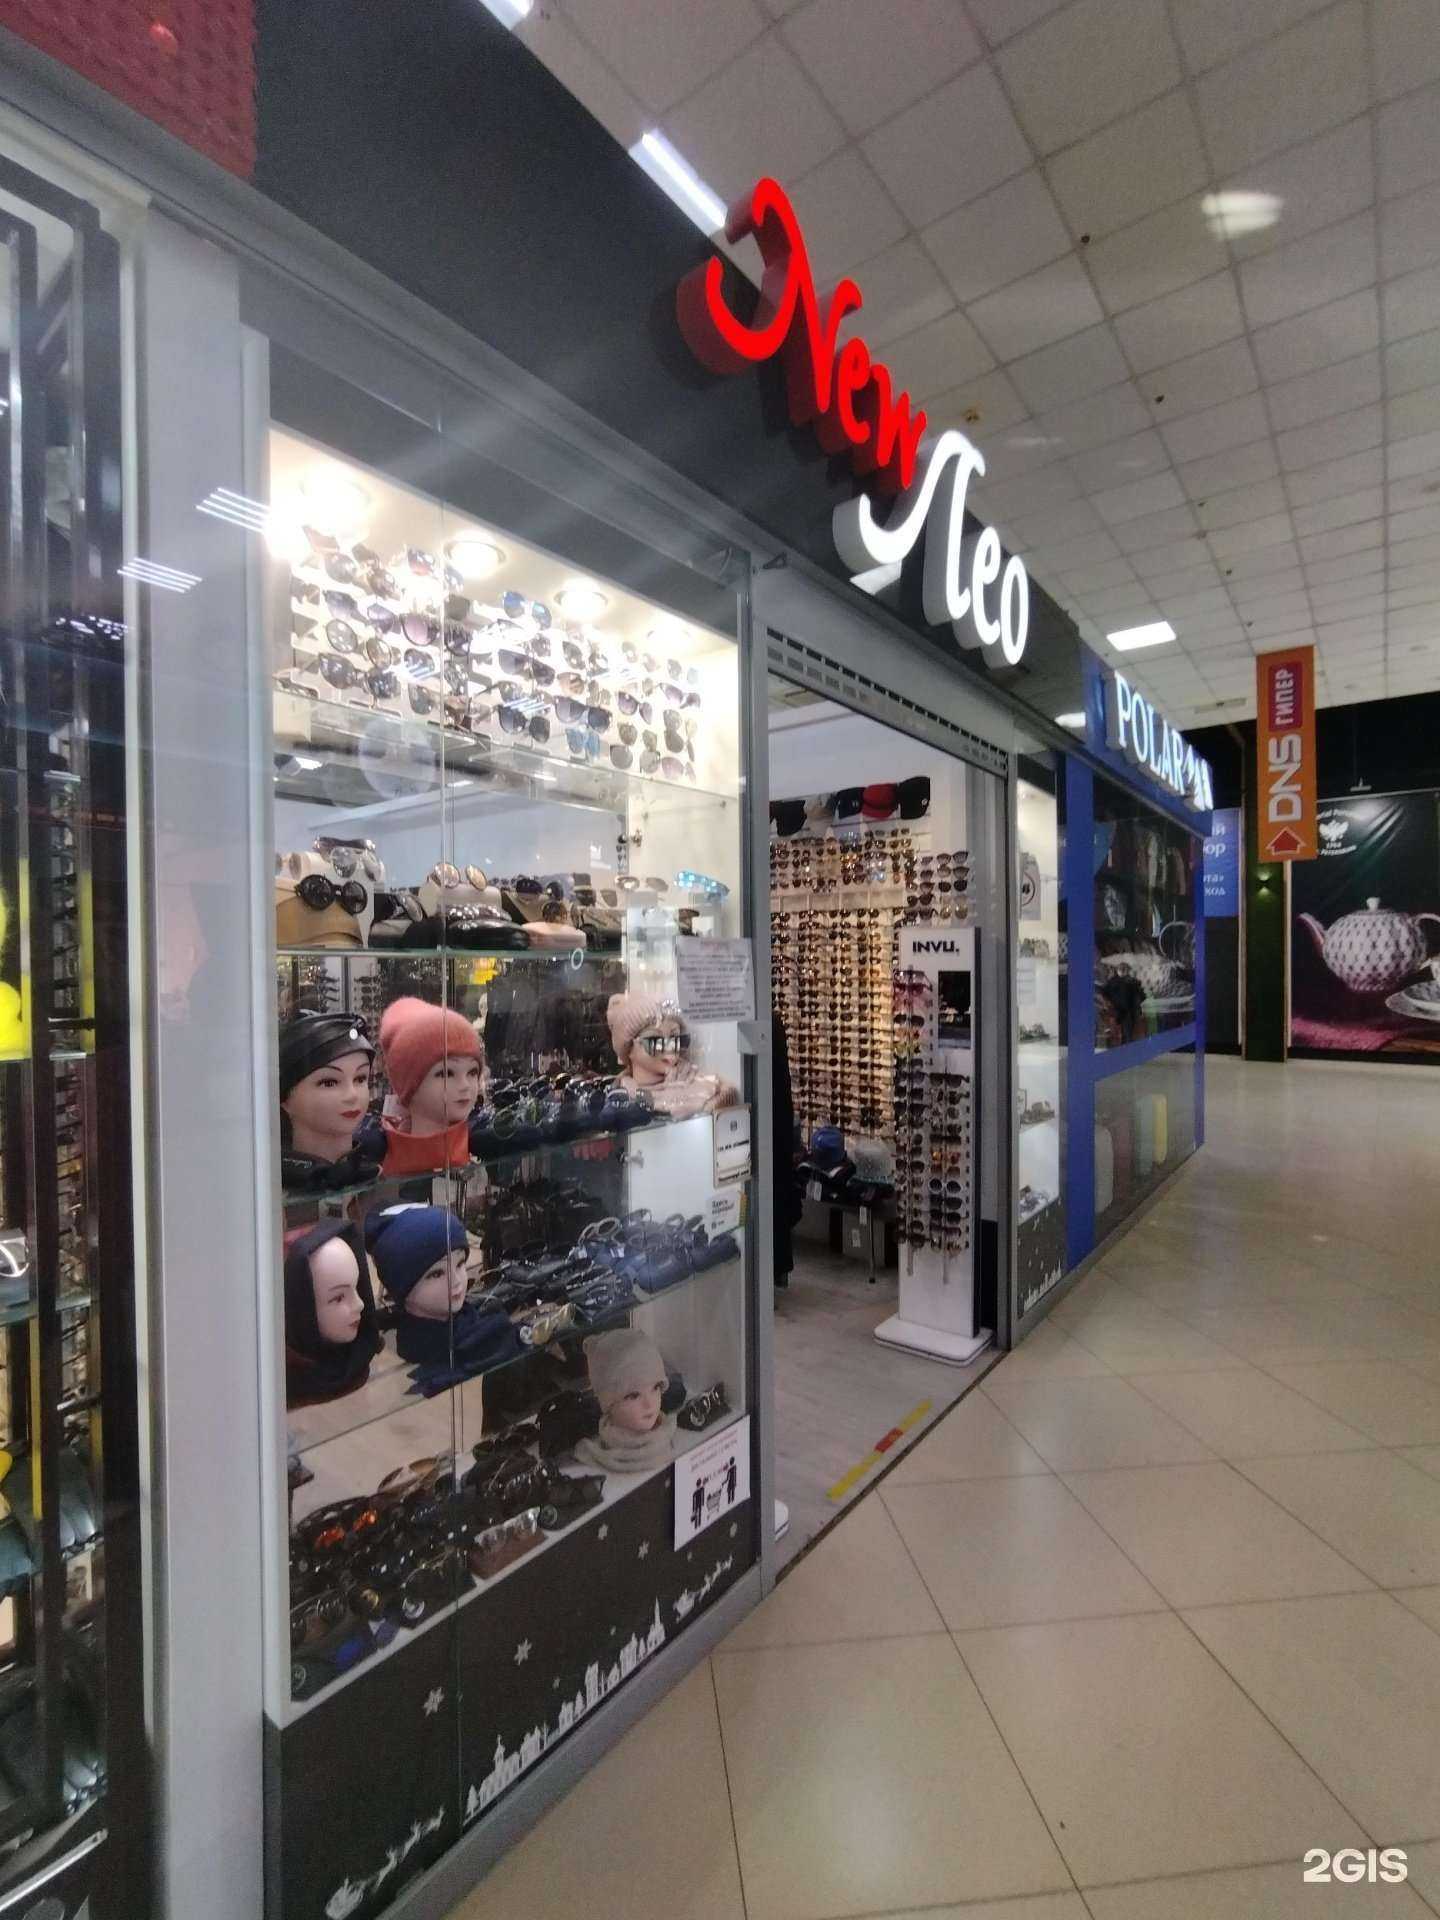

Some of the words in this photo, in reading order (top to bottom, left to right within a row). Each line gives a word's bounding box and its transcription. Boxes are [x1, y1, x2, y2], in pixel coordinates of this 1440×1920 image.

[704, 177, 927, 489] New
[1275, 667, 1294, 726] ГИПЕР
[1268, 733, 1302, 823] DNS
